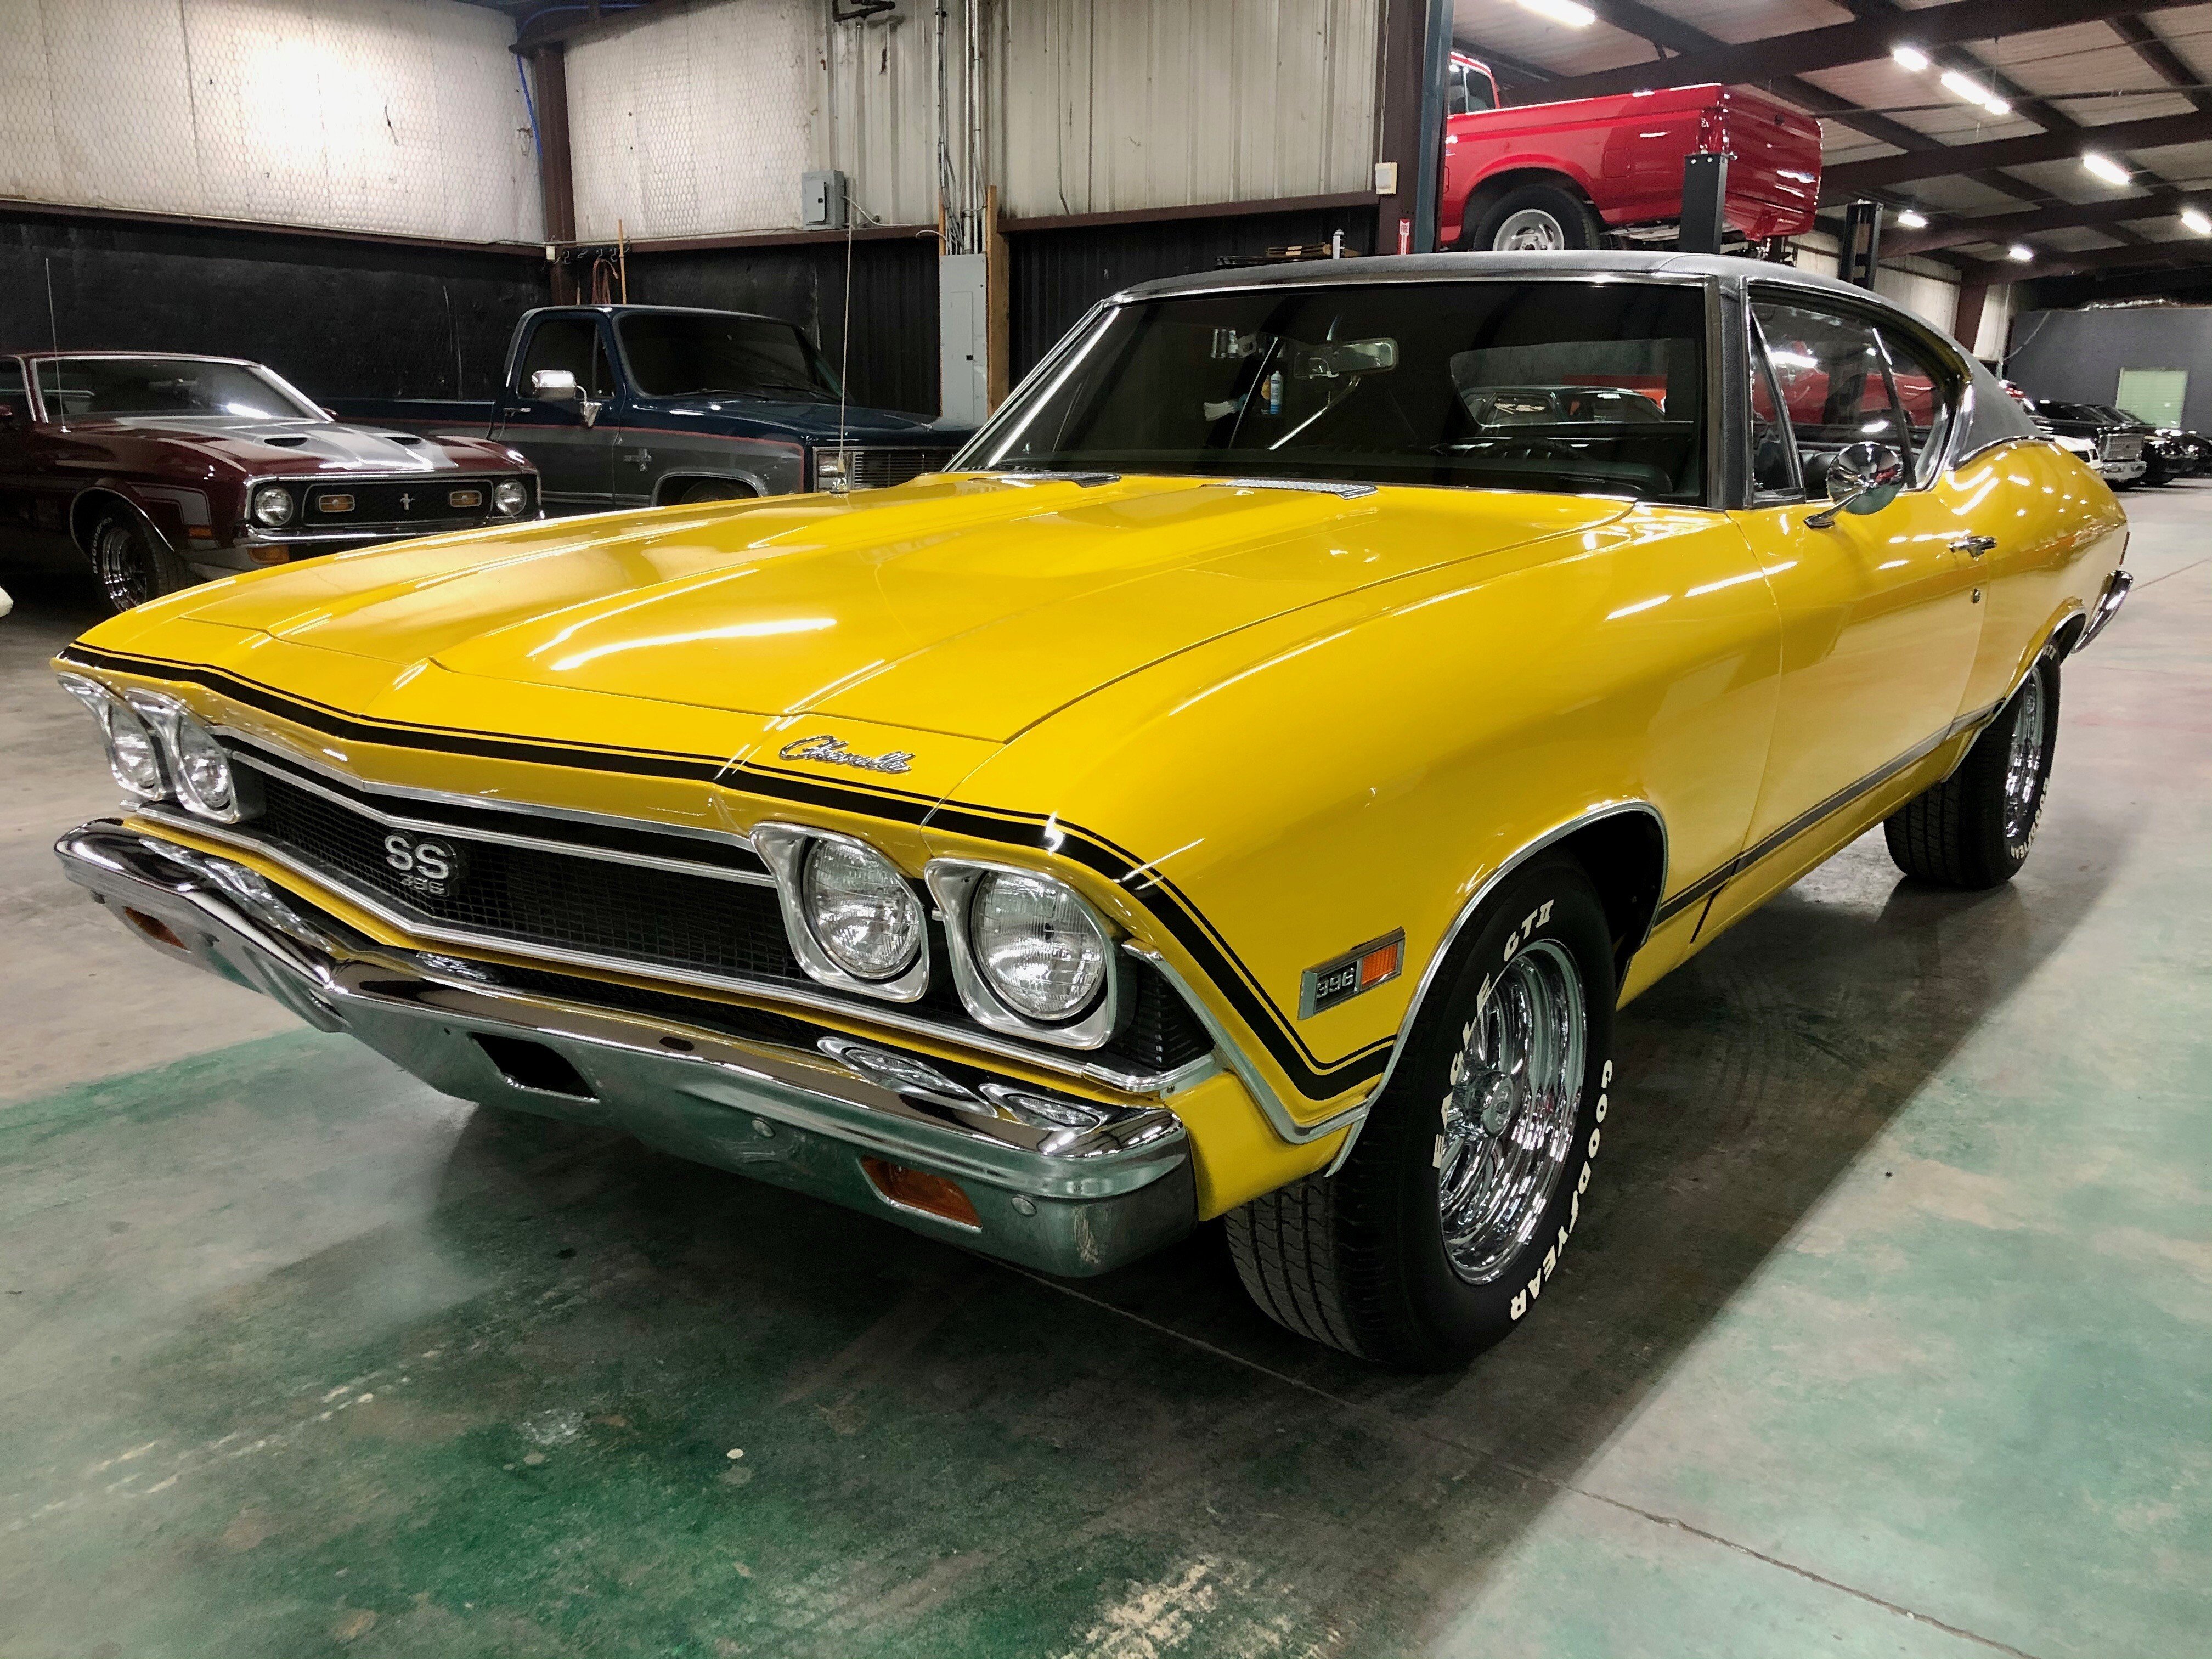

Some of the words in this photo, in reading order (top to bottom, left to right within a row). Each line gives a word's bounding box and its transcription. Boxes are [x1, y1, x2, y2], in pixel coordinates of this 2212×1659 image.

[385, 835, 449, 879] SS
[1317, 968, 1355, 998] 396
[1511, 1060, 1612, 1320] GOODYEAR
